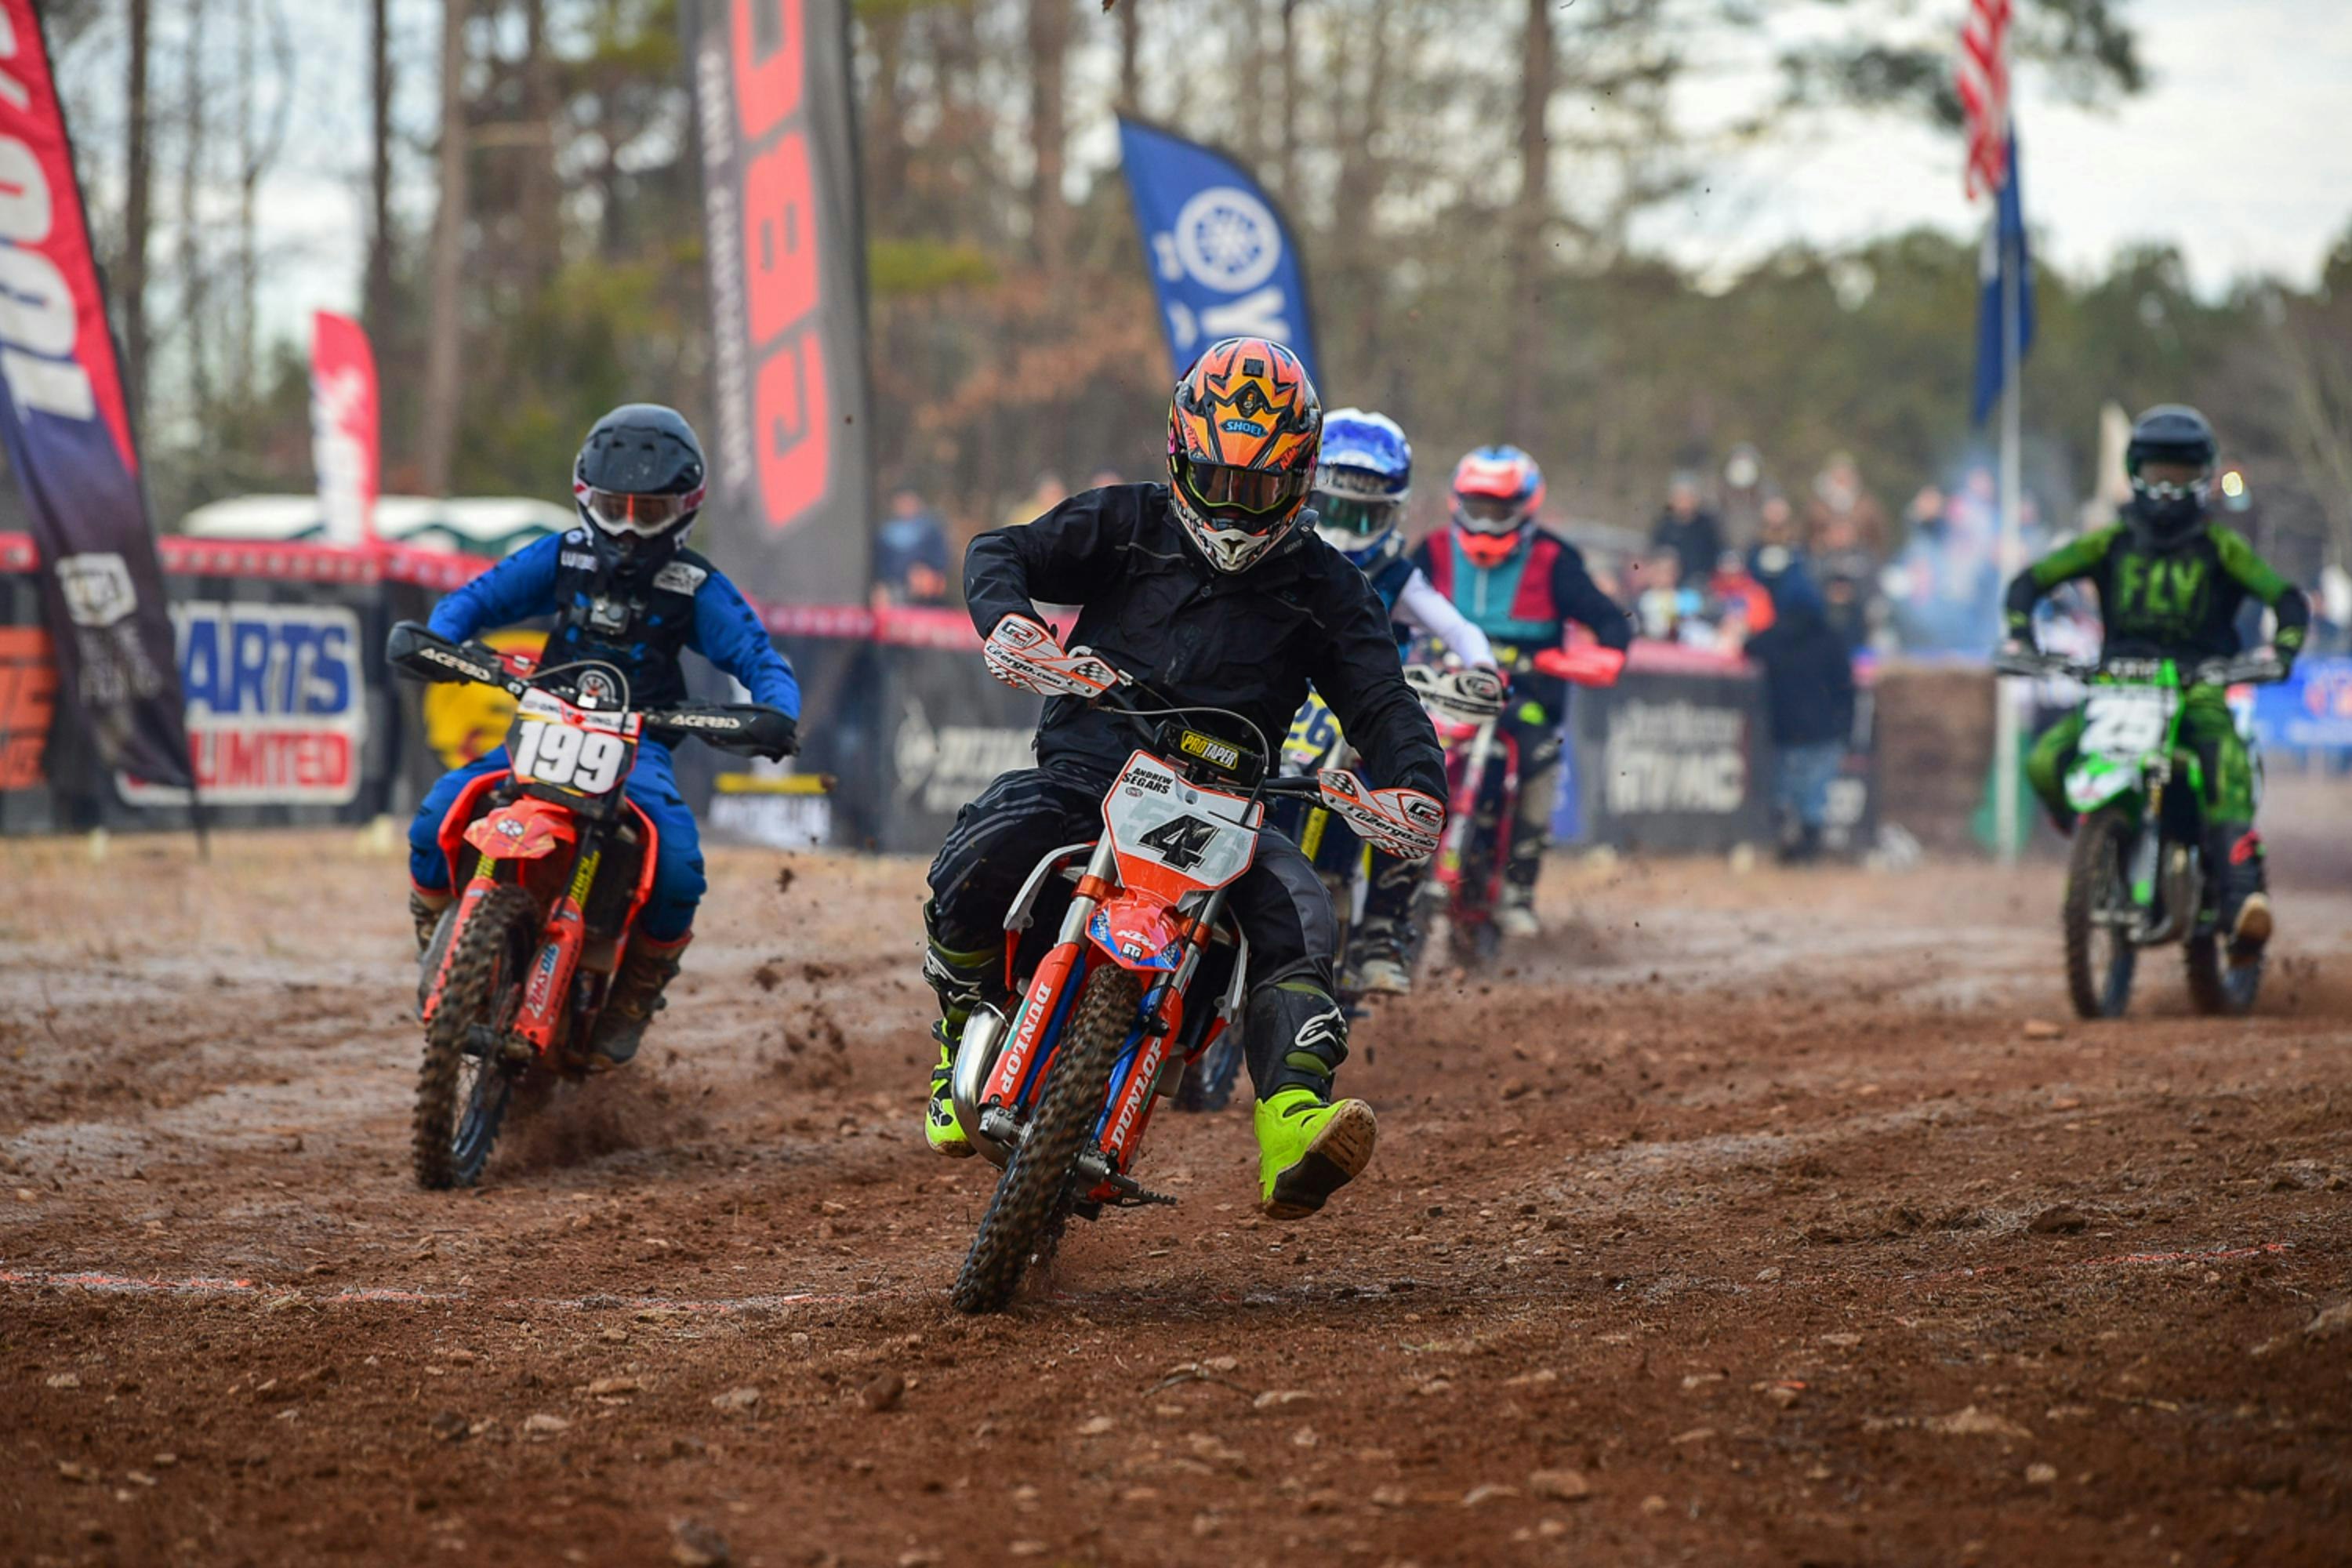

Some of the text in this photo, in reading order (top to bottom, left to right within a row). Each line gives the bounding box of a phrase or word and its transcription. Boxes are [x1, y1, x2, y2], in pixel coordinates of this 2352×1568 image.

[1226, 421, 1261, 435] SHOEI
[2121, 554, 2205, 614] FLY
[181, 620, 350, 714] ARTS
[419, 648, 492, 681] ACERBIS
[670, 713, 741, 729] ACERBIS
[189, 729, 350, 789] LIMITED
[514, 720, 625, 794] 199
[1122, 772, 1171, 794] SEGARS
[1132, 767, 1174, 785] ANDREW
[1137, 813, 1221, 873] 4
[1116, 930, 1158, 951] KTM
[1000, 982, 1051, 1094] DUNLOP
[1111, 1036, 1163, 1149] DUNLOP
